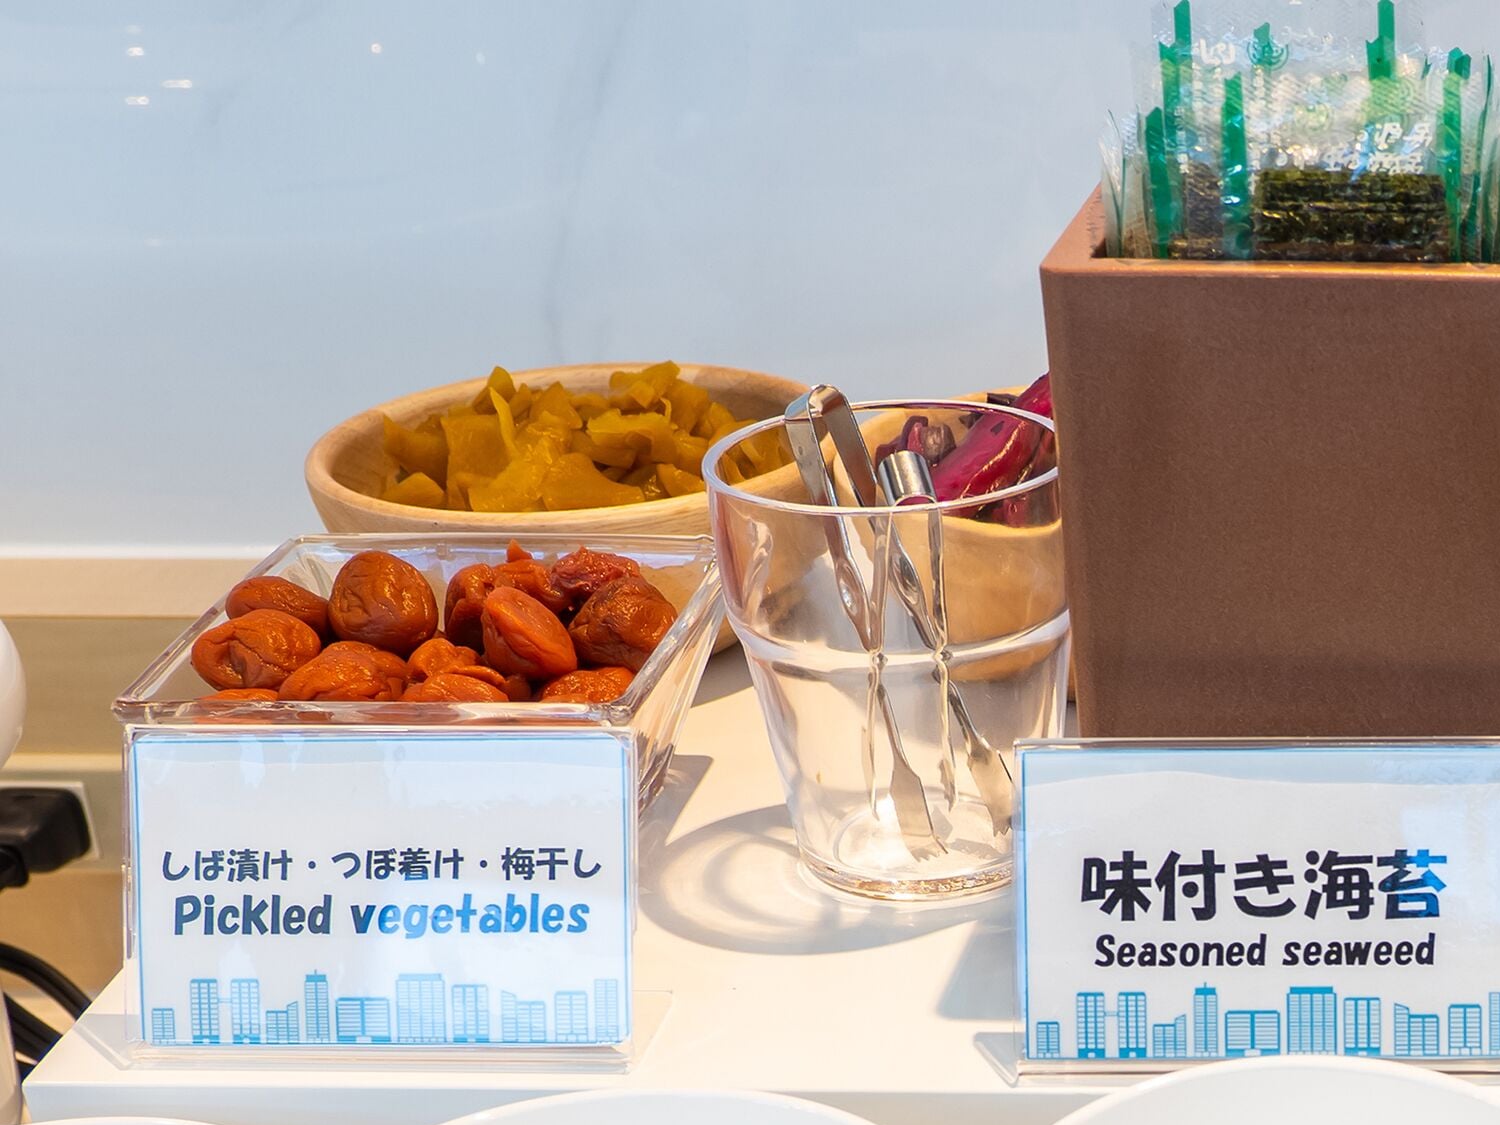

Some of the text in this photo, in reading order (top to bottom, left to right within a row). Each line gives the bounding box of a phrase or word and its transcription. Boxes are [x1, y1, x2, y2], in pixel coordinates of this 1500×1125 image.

[1081, 848, 1448, 922] 味付き海苔
[174, 892, 590, 939] Pickled vegetables
[1094, 932, 1436, 968] Seasoned seaweed
